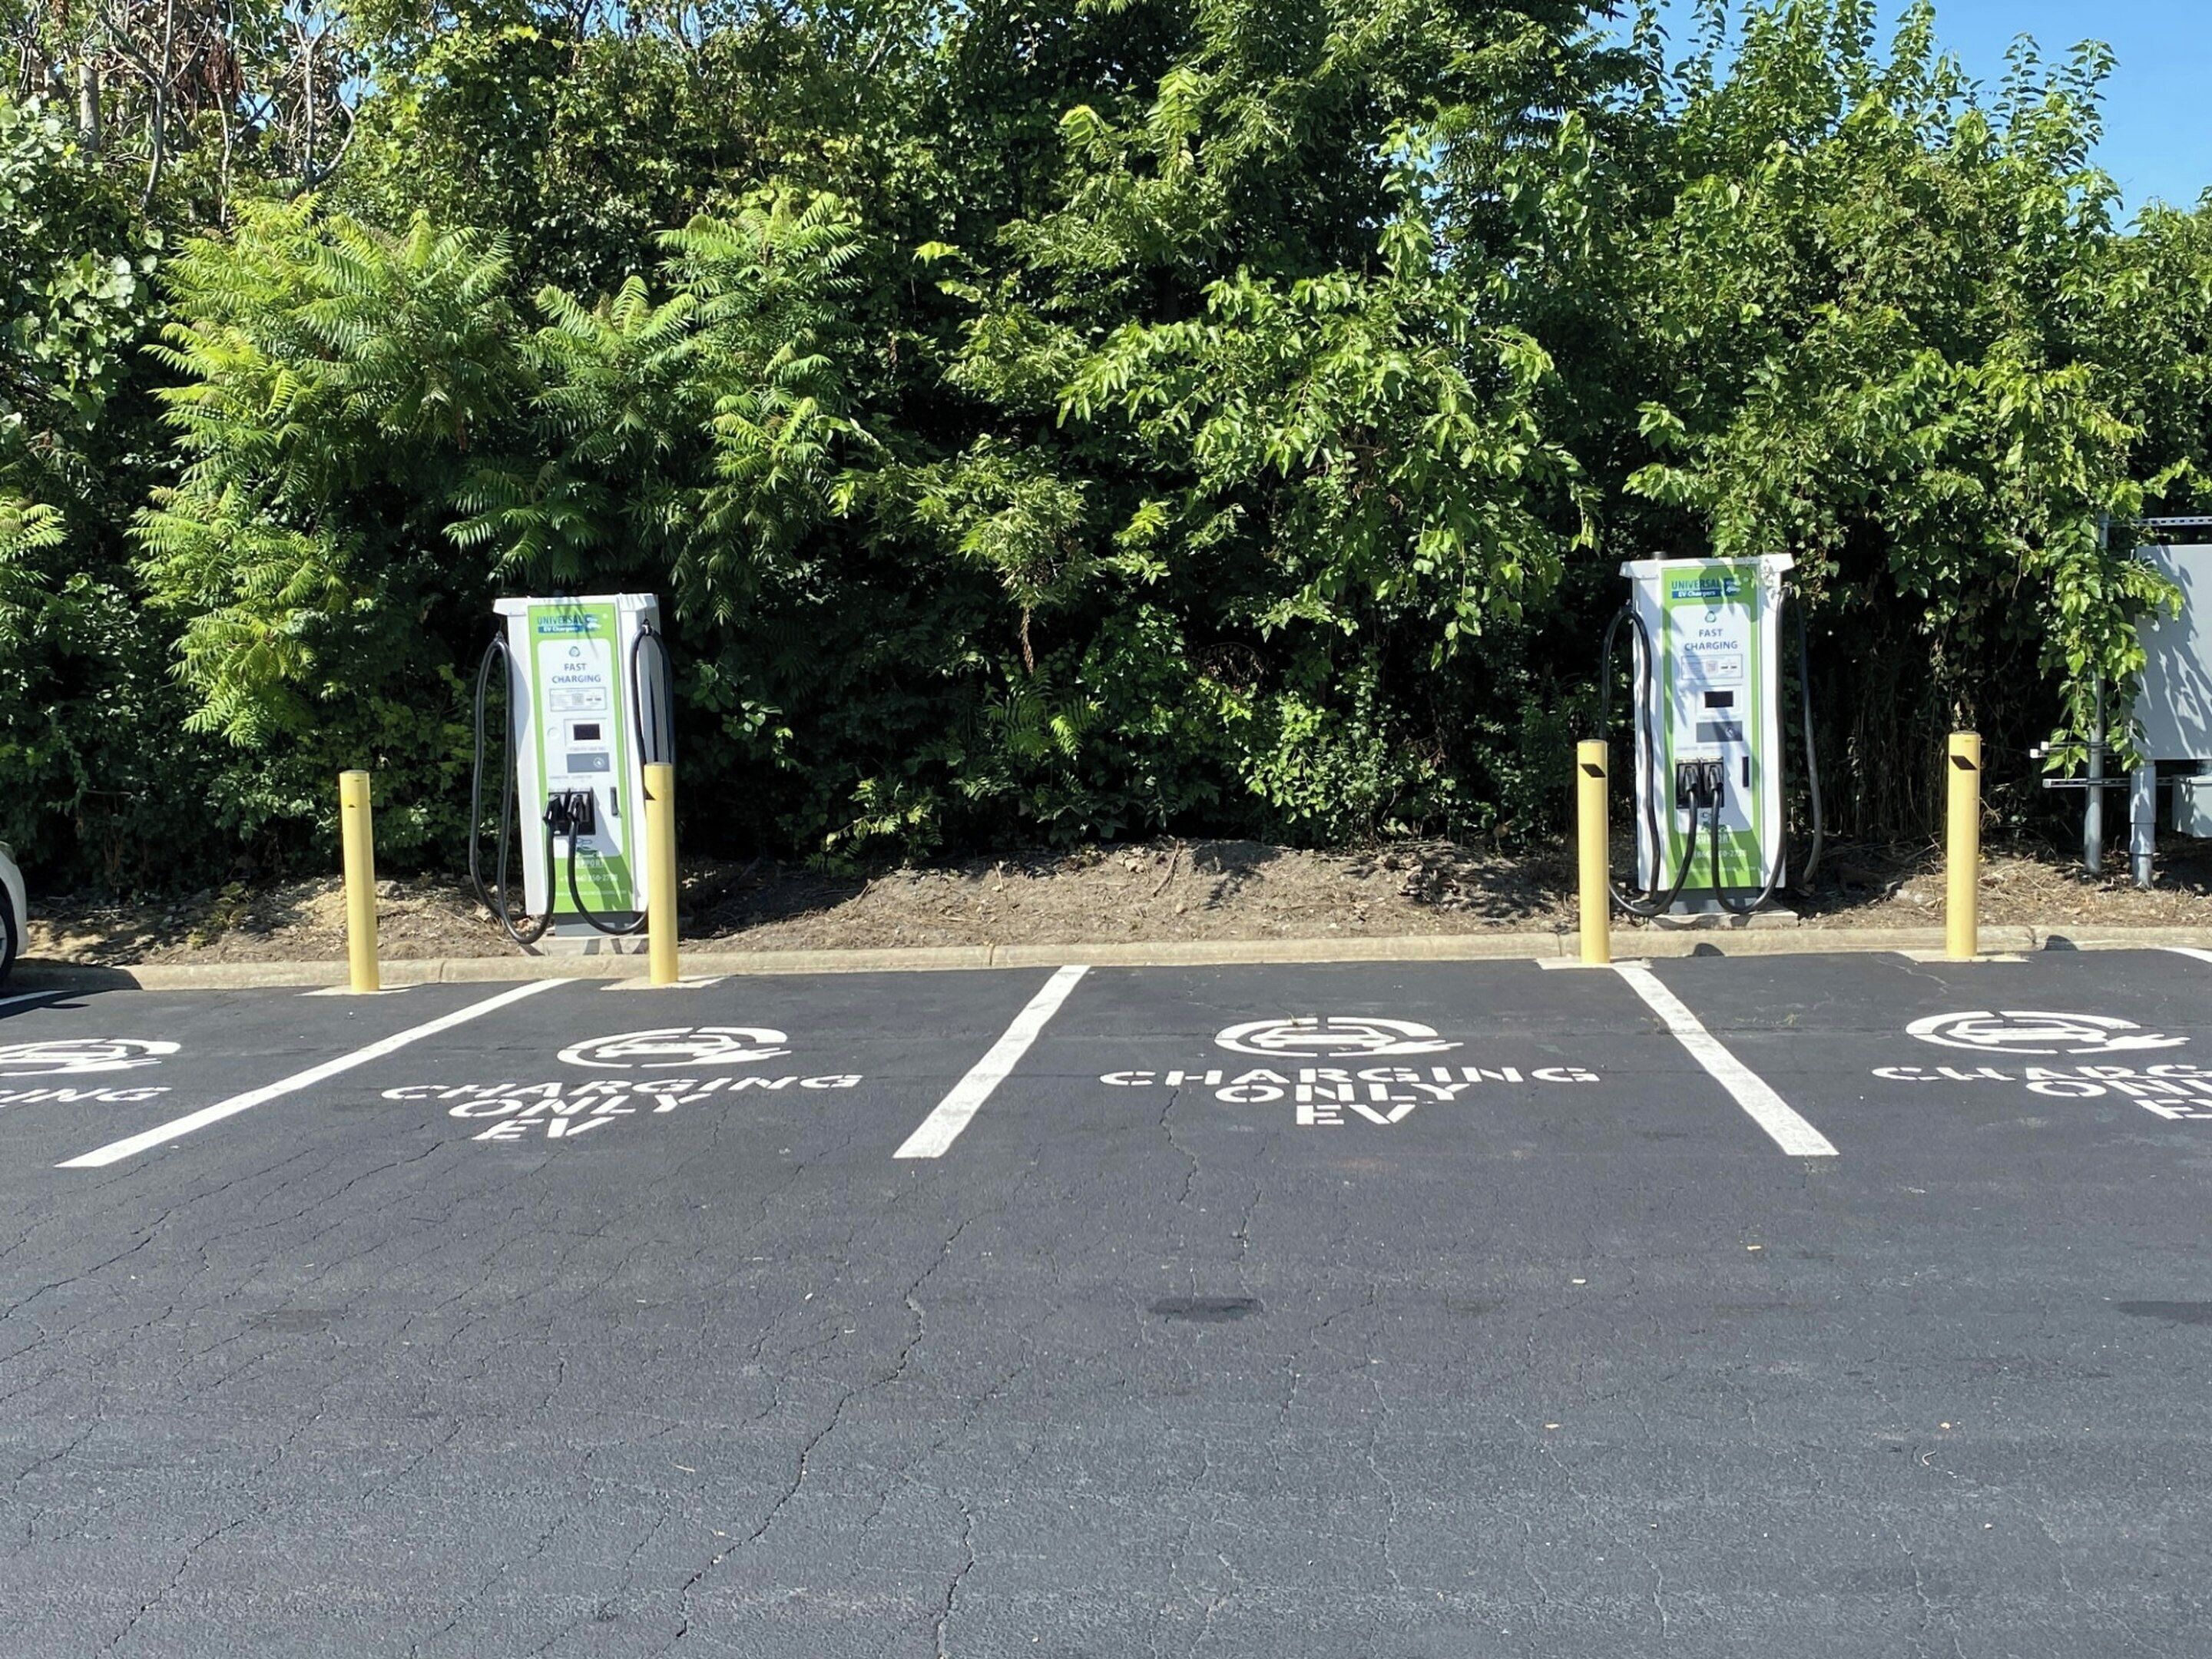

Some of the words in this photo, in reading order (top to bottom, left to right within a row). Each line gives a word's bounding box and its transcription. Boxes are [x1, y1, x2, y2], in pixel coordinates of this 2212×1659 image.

[1671, 579, 1723, 589] UNIVERSAL
[538, 615, 584, 625] UNIVERSAL
[1698, 628, 1723, 637] FAST
[1685, 641, 1738, 651] CHARGING
[551, 674, 601, 684] CHARGING
[1099, 1067, 1601, 1085] CHARGING
[381, 1075, 863, 1099] CHARGING
[1214, 1083, 1470, 1102] ONLY
[448, 1093, 711, 1118] ONLY
[1296, 1104, 1416, 1125] EV
[471, 1116, 616, 1141] EV
